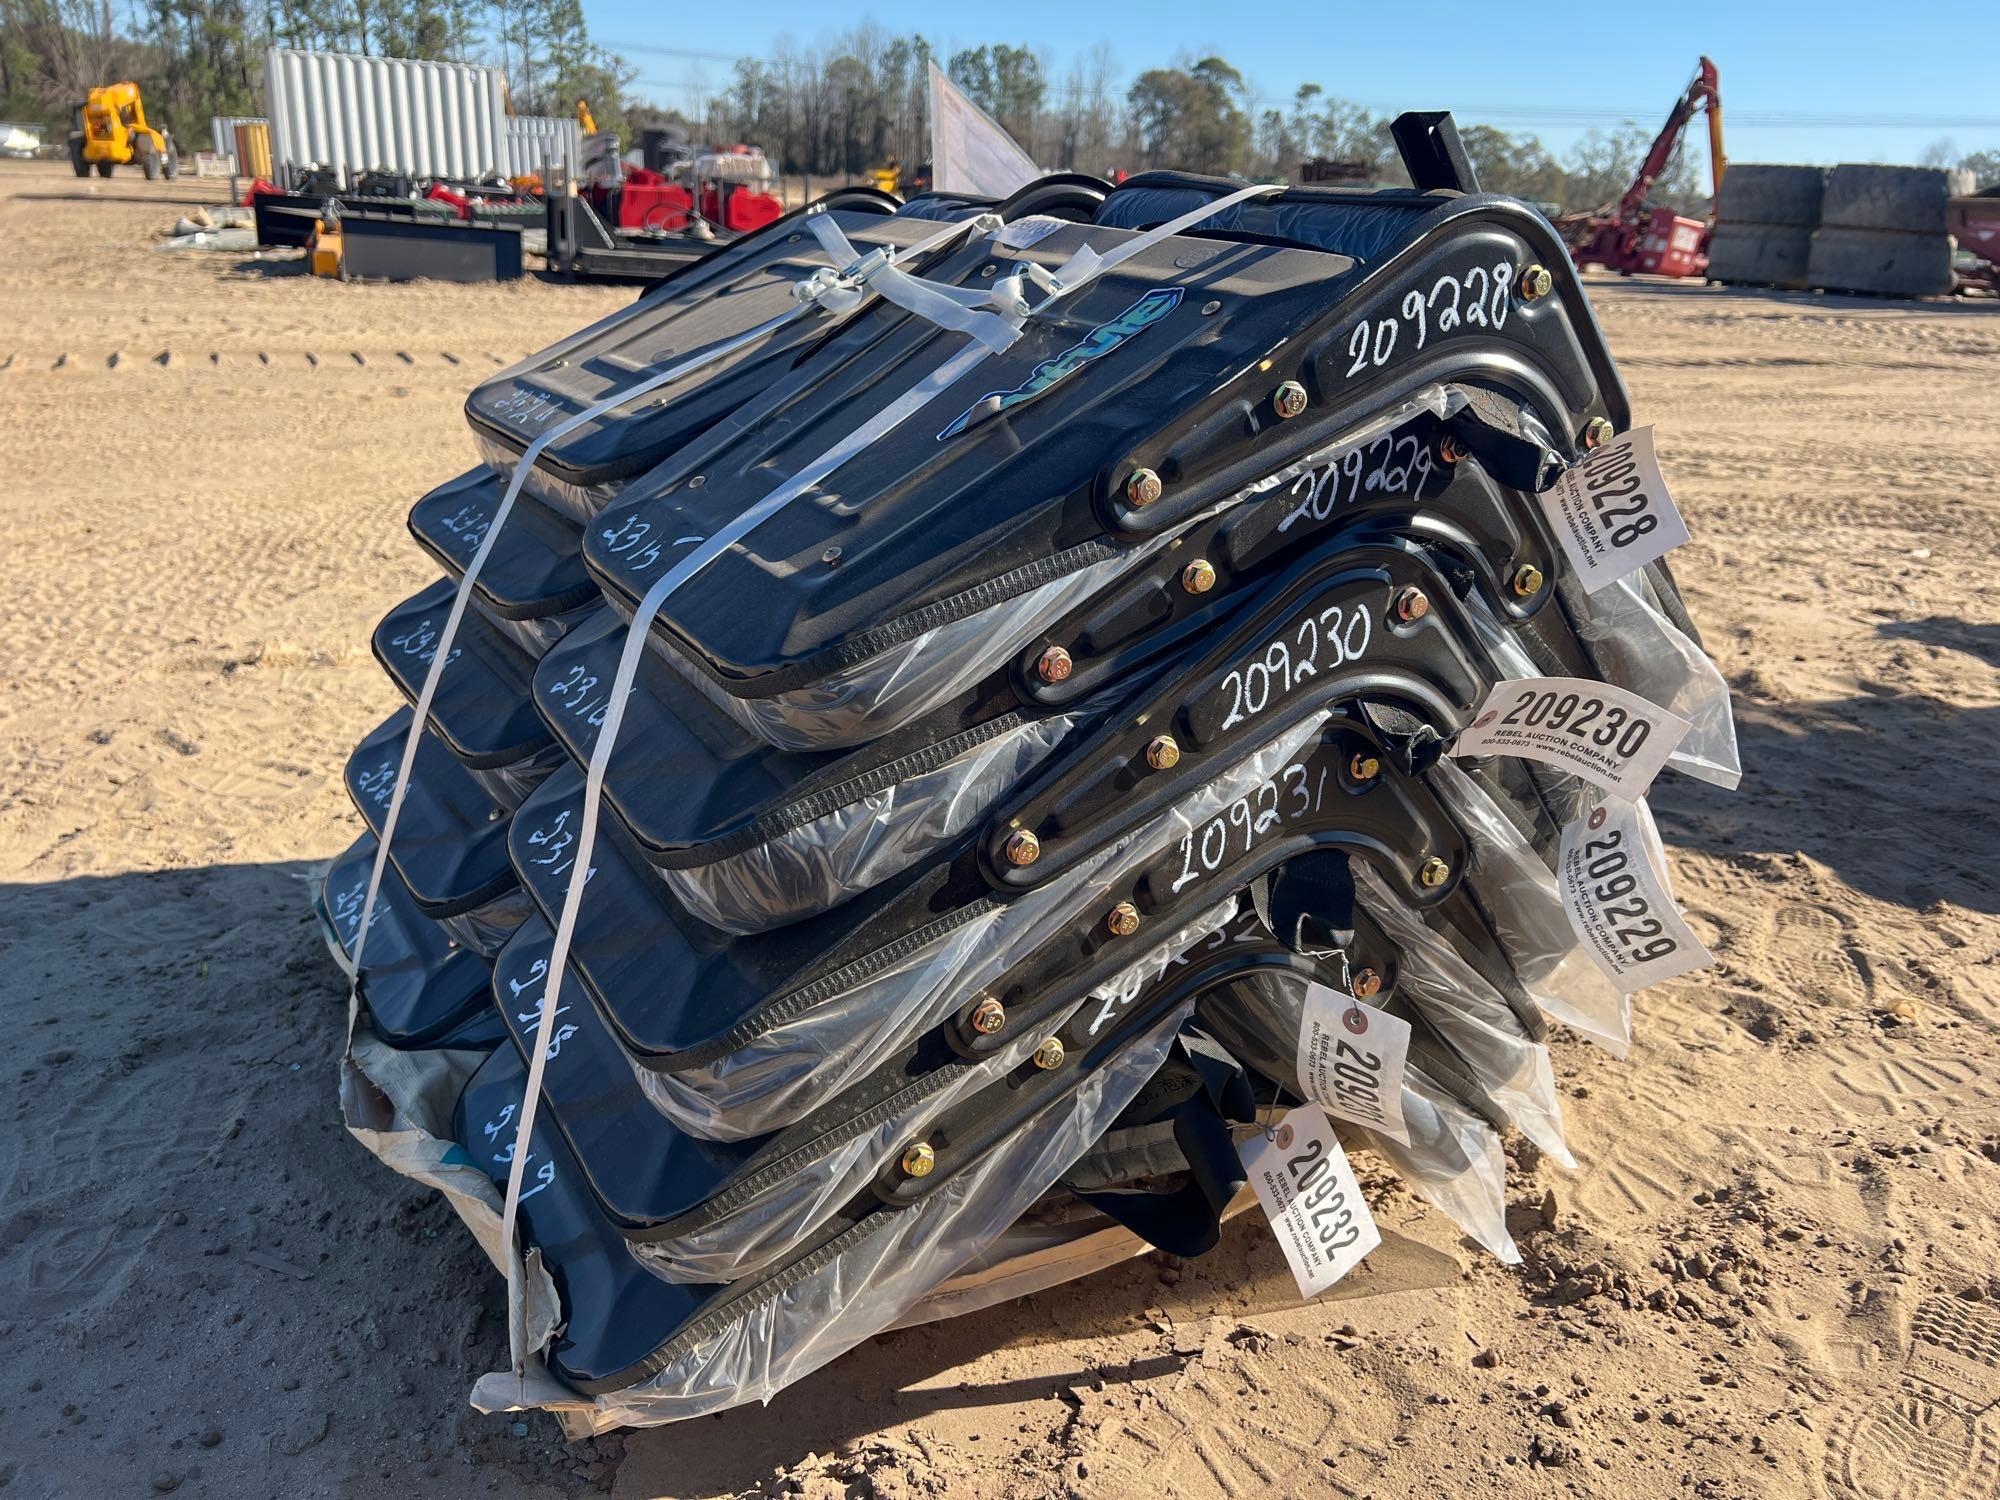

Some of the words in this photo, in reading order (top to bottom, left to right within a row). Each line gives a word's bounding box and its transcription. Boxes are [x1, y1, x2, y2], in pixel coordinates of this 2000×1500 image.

[1346, 261, 1513, 378] 209228
[1277, 433, 1432, 532] 209229
[1583, 442, 1658, 547] 209228
[1559, 498, 1598, 569] www.rebelauction.net
[1578, 511, 1606, 554] COMPANY
[1222, 604, 1372, 731] 209230
[1494, 729, 1524, 739] REBEL
[1526, 731, 1568, 747] AUCTION
[1569, 742, 1621, 770] COMPANY
[1501, 690, 1652, 759] 209230
[1535, 743, 1622, 784] www.rebelauction.net
[1172, 763, 1328, 894] 209231
[1573, 900, 1624, 975] www.rebelauction.net
[1577, 880, 1599, 922] AUCTION
[1595, 923, 1629, 965] COMPANY
[1585, 830, 1677, 962] 209229
[1319, 1033, 1330, 1061] REBEL
[1275, 1171, 1290, 1198] REBEL
[1287, 1198, 1306, 1232] AUCTION
[1302, 1231, 1323, 1267] COMPANY
[1286, 1140, 1360, 1262] 209232
